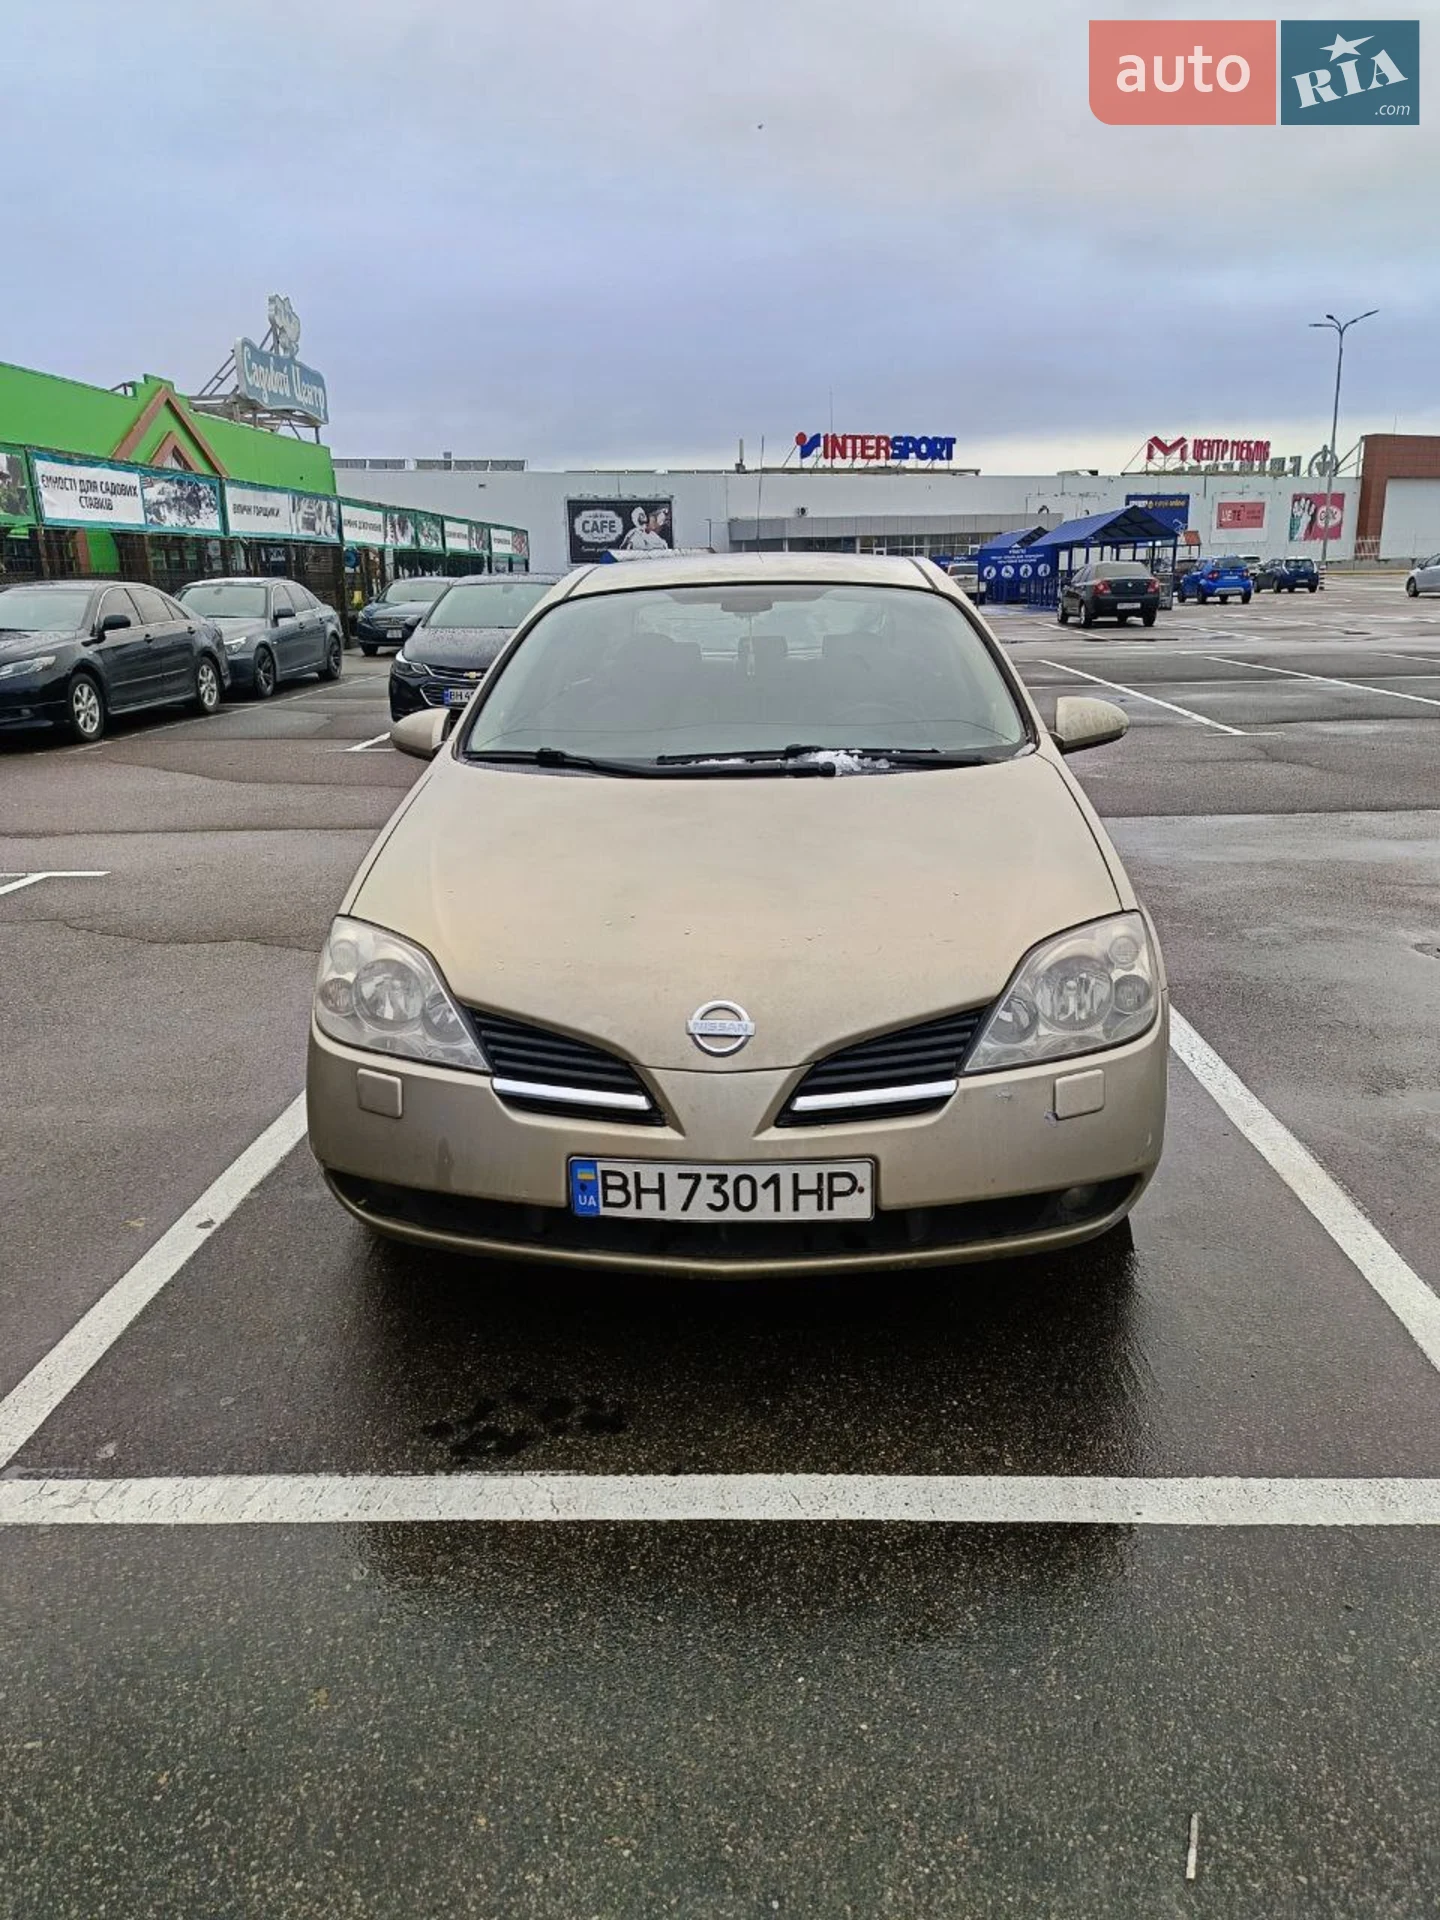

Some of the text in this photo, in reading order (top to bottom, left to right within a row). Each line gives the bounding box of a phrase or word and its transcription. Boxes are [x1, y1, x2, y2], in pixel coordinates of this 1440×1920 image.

[822, 433, 956, 461] INTERSPORT
[1192, 438, 1230, 462] ЦЕНТР
[79, 479, 98, 494] ДЛЯ
[100, 481, 138, 498] САДОВИХ
[79, 496, 113, 511] СТАВКІВ
[581, 519, 617, 534] CAFE
[692, 1021, 749, 1033] NISSAN
[601, 1169, 858, 1213] BH 7301 HP
[578, 1195, 597, 1207] UA
